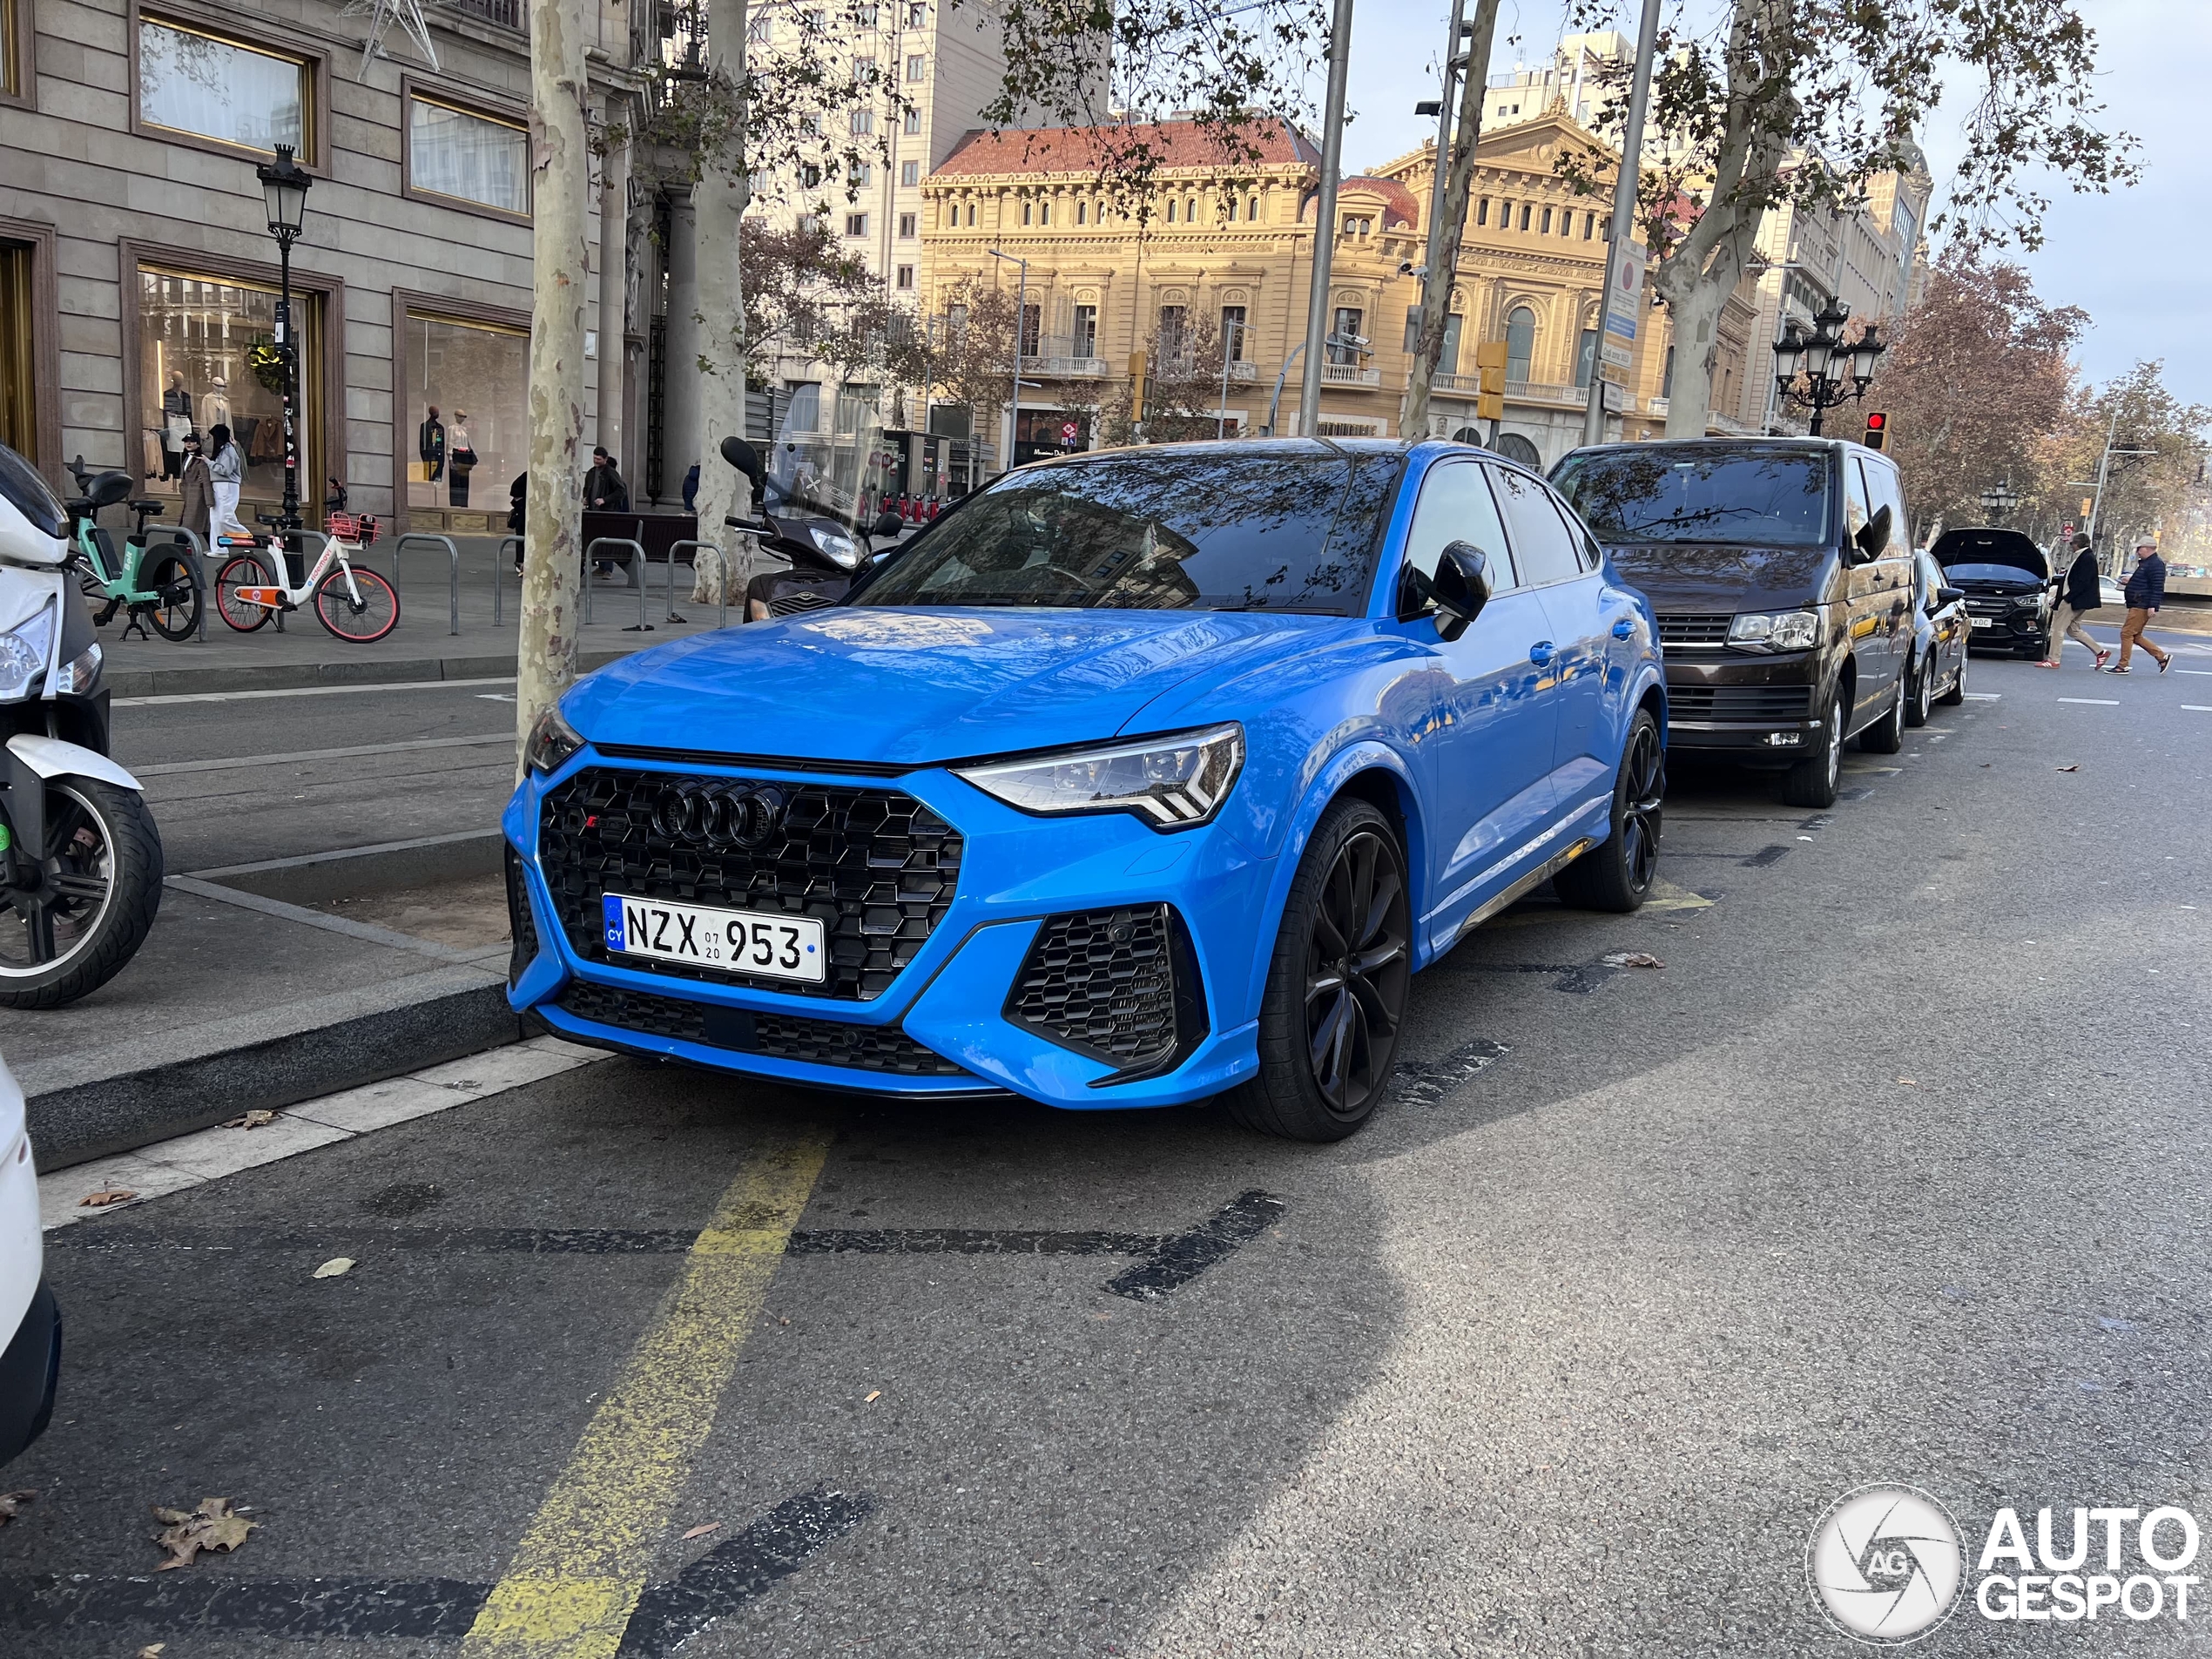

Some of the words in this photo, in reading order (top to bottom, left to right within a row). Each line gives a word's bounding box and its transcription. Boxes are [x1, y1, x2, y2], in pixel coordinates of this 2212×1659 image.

[124, 550, 133, 571] Bolt
[311, 547, 332, 581] ridemovi
[608, 928, 623, 942] CY
[627, 906, 699, 956] NZX
[725, 920, 800, 969] 953
[705, 932, 719, 944] 07
[705, 948, 720, 959] 20
